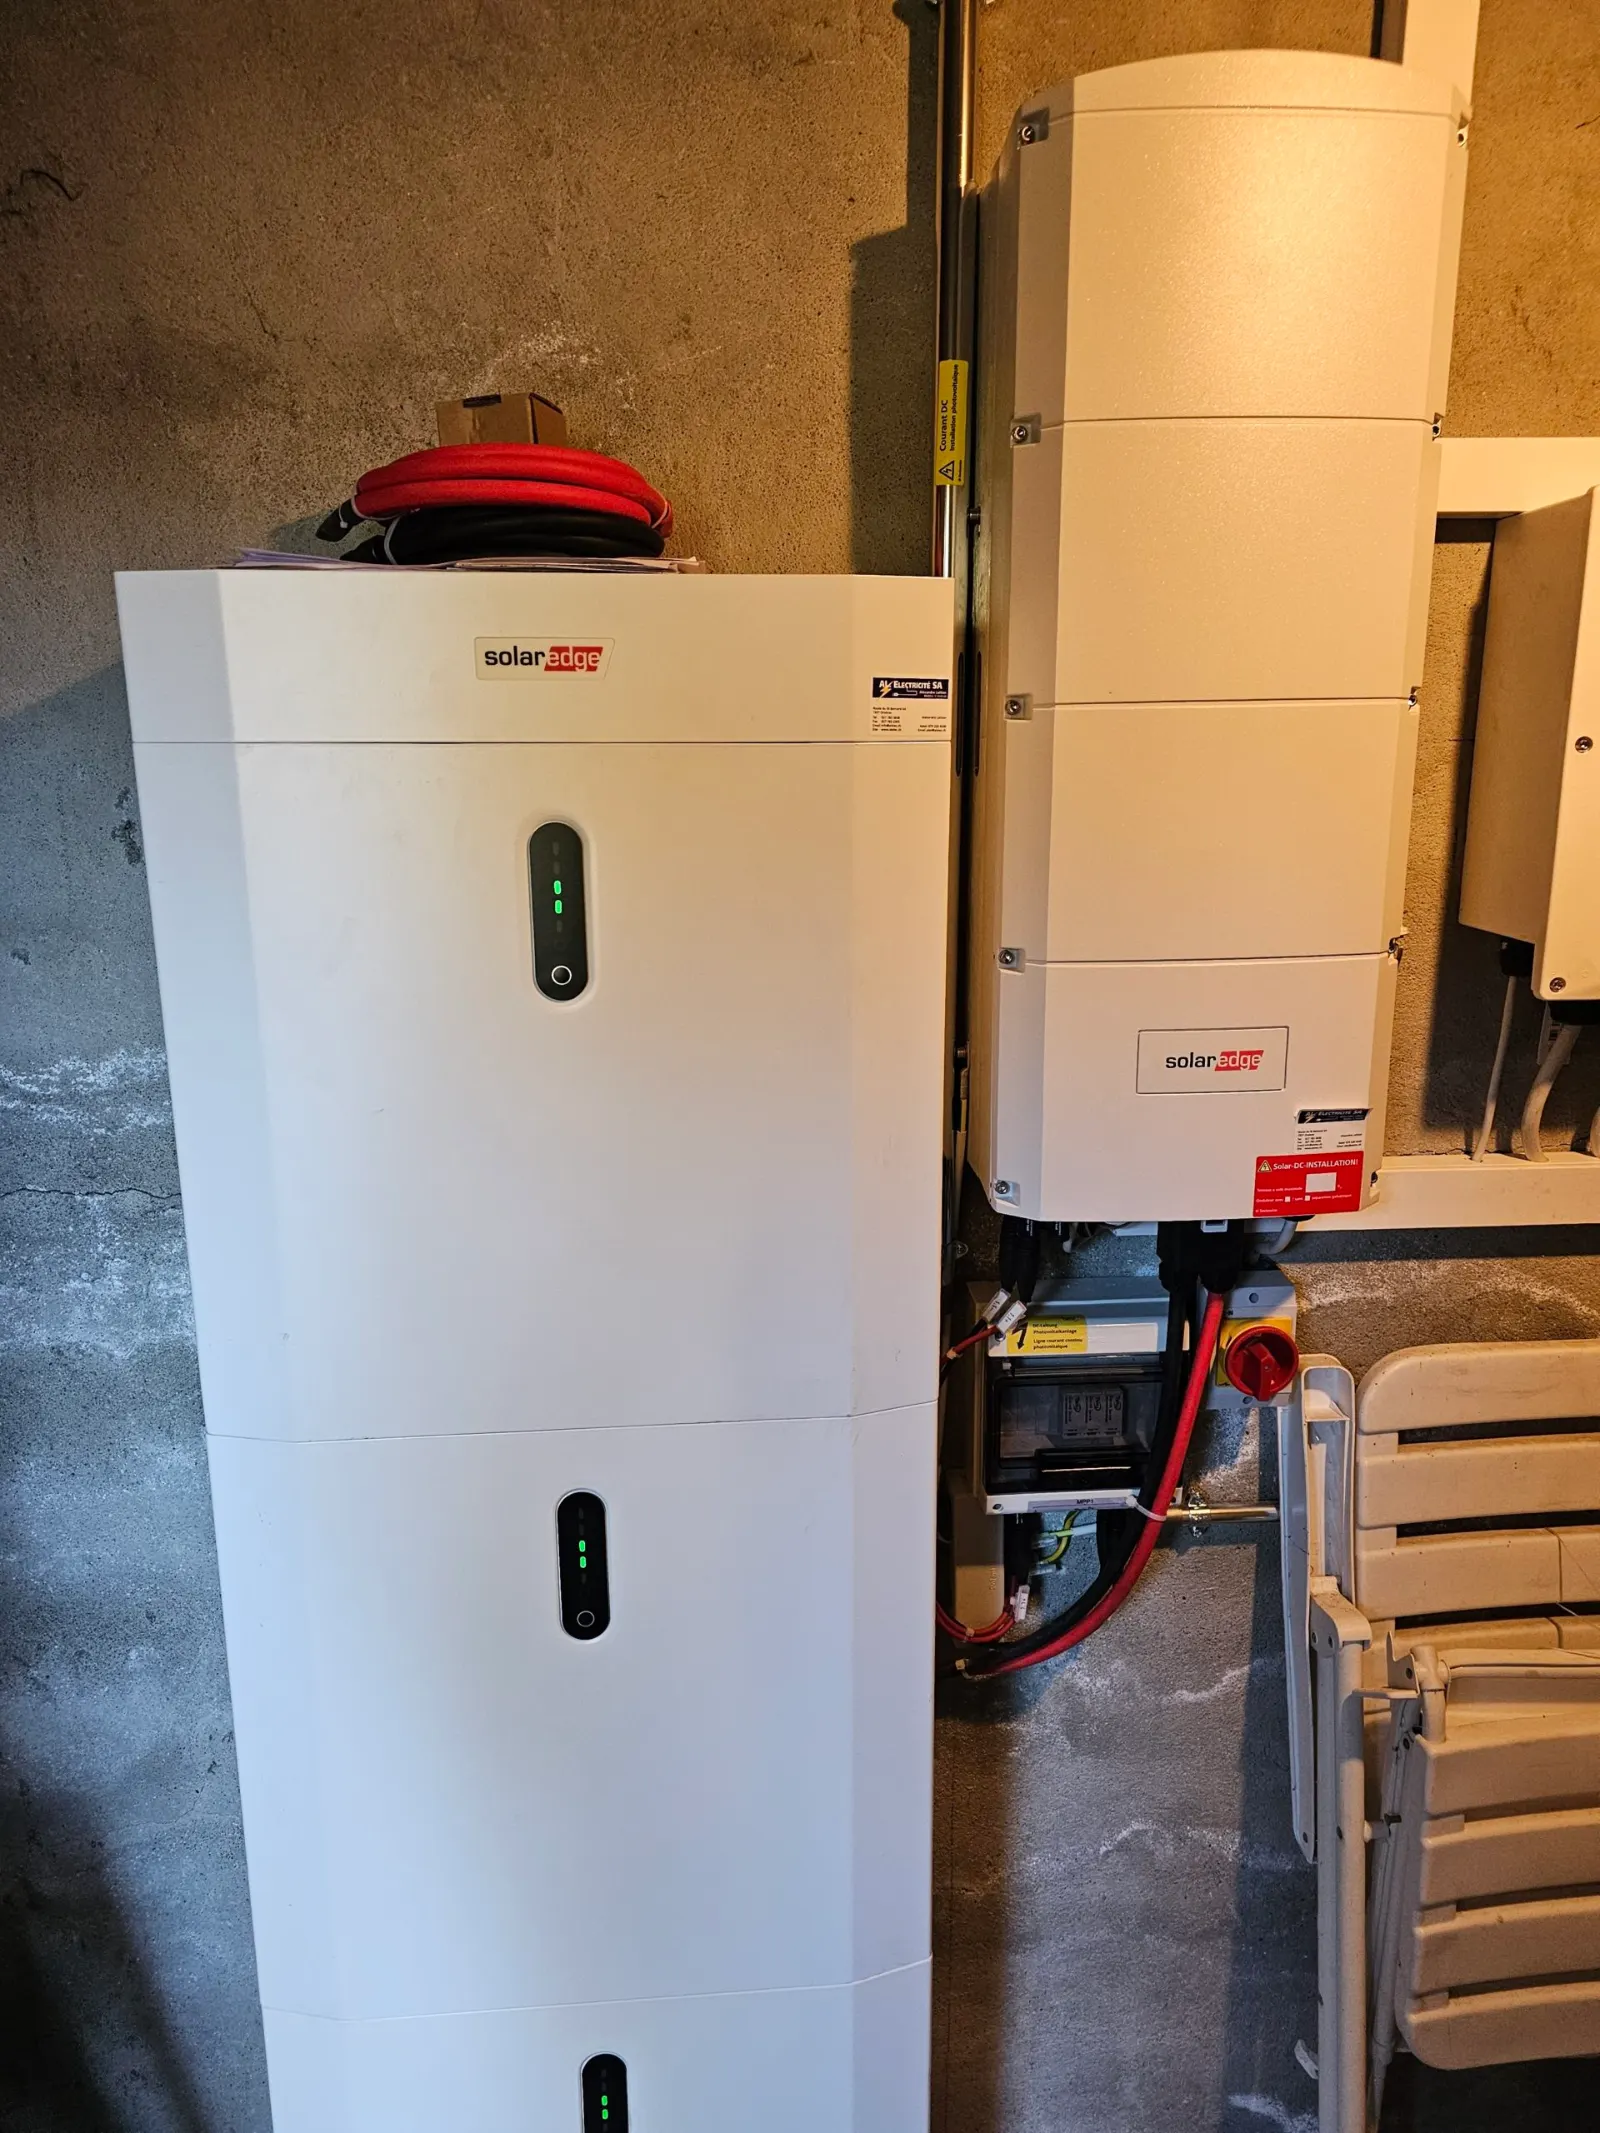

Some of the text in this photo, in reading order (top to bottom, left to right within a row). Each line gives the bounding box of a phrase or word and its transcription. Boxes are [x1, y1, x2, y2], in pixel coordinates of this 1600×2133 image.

[939, 399, 948, 452] Courant DC
[949, 415, 957, 452] Installation
[484, 645, 603, 672] solaredge
[932, 681, 943, 690] SA
[1165, 1050, 1264, 1071] solaredge
